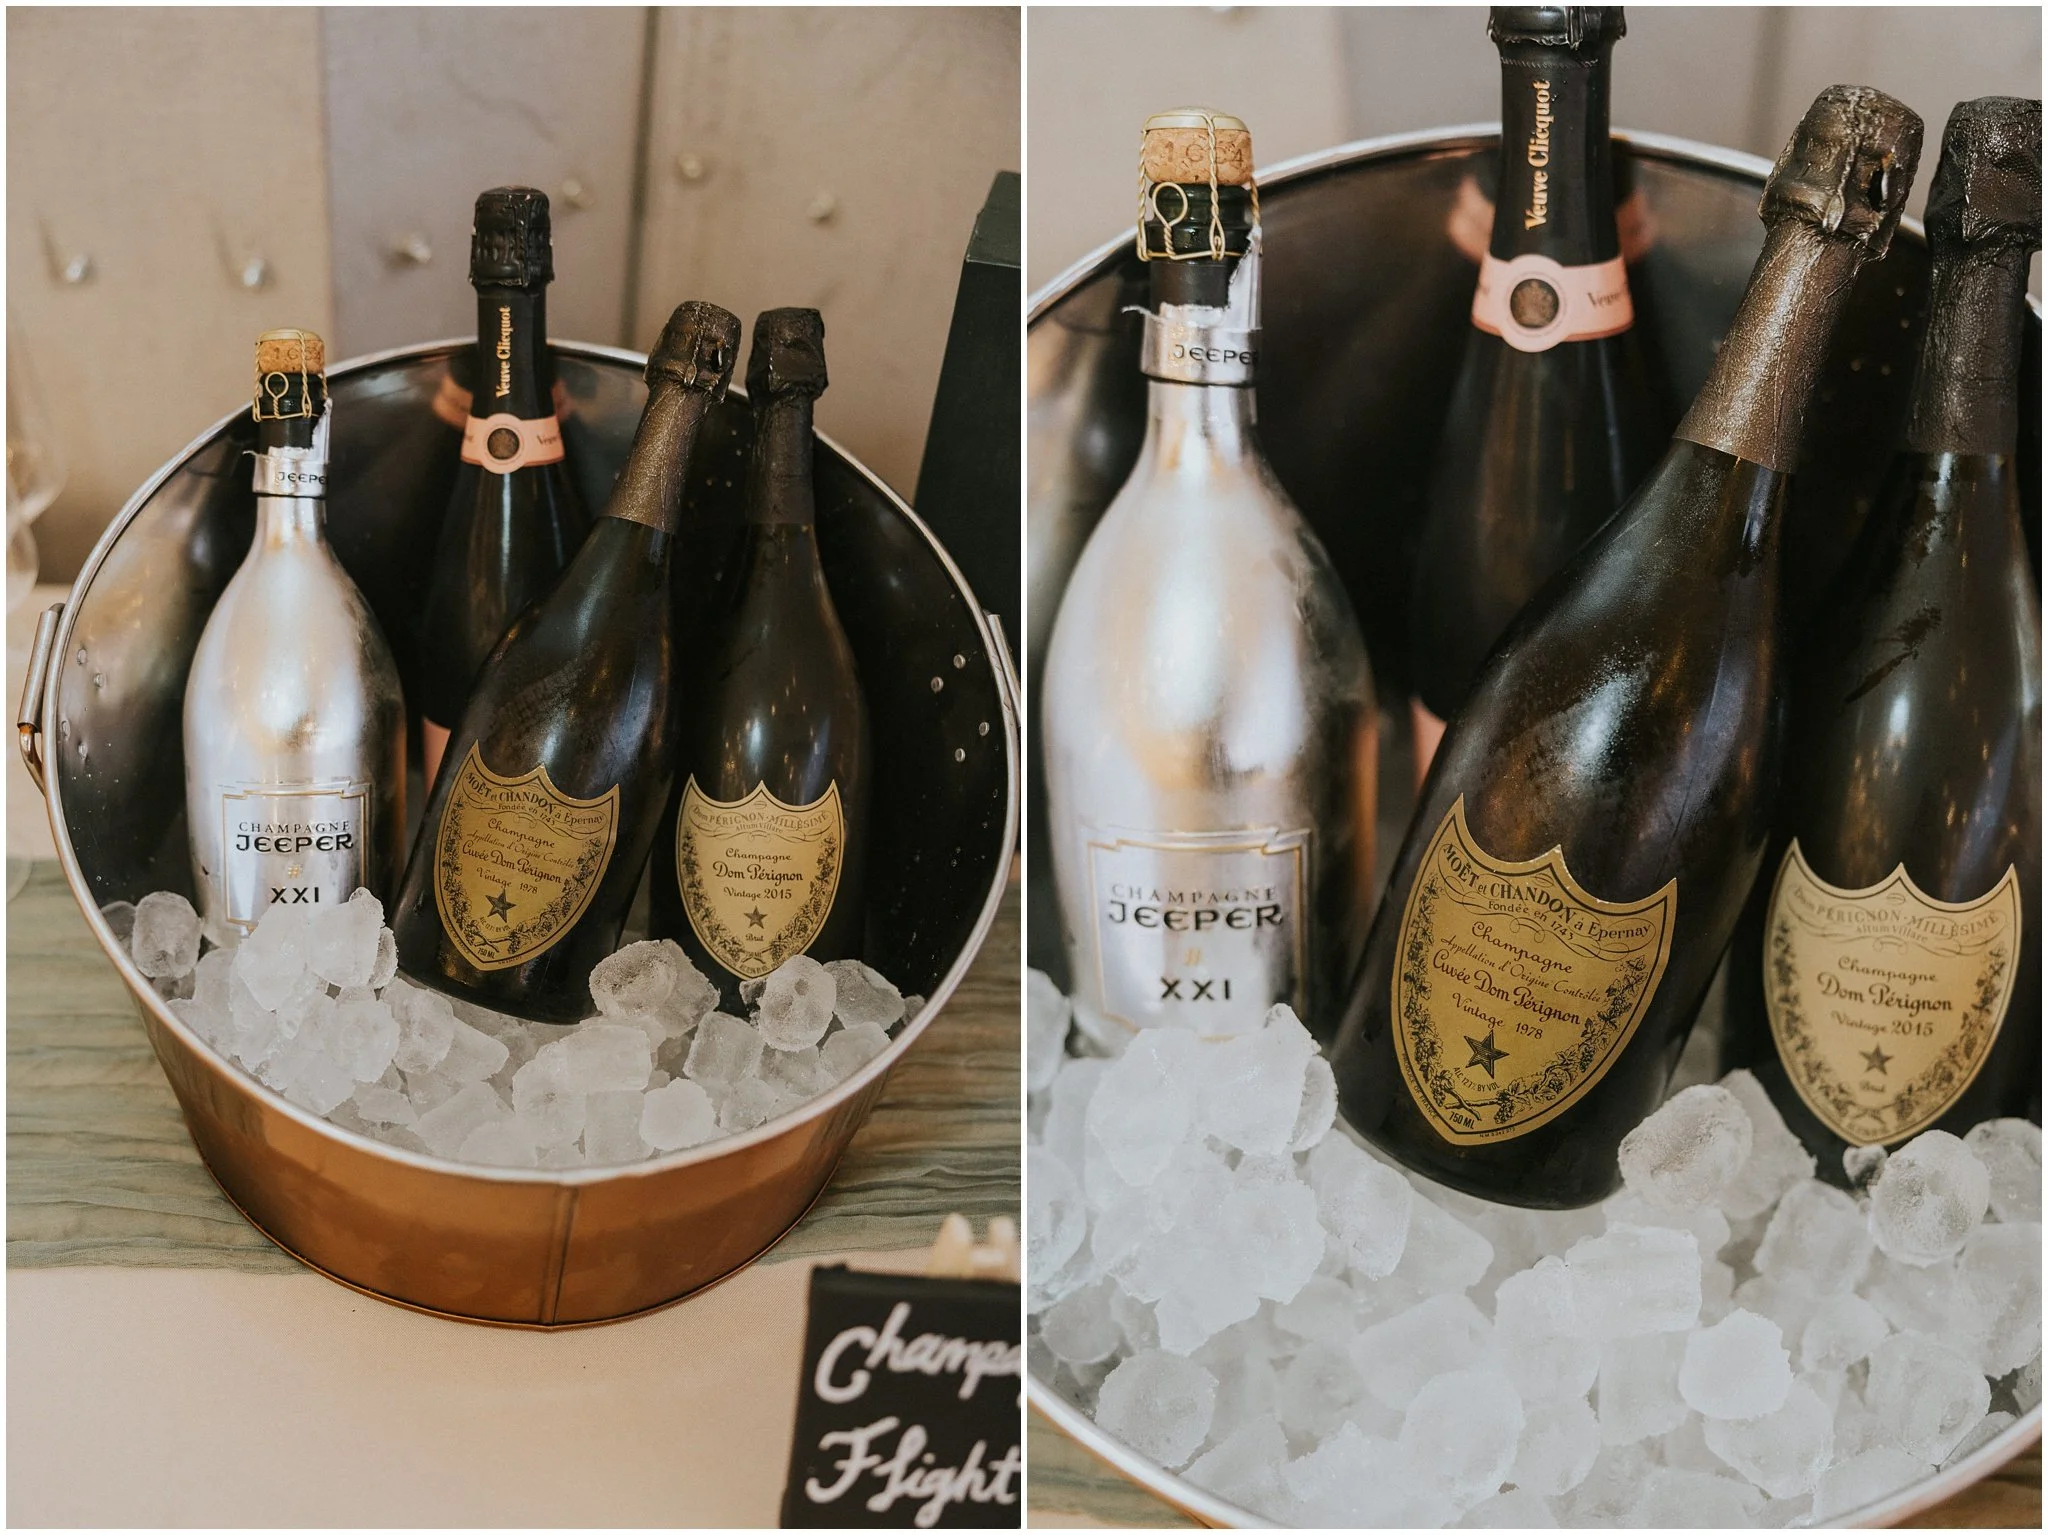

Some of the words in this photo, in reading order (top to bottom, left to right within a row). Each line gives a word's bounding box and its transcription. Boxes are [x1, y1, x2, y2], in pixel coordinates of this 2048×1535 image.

[1527, 79, 1554, 168] Clicquot
[1524, 170, 1549, 230] Veuve
[496, 306, 513, 360] Clicquot
[496, 361, 511, 398] Veuve
[277, 471, 329, 485] JEEPE
[499, 791, 557, 815] CHANDON
[236, 832, 354, 853] JEEPER
[238, 820, 351, 834] CHAMPAGNE
[488, 818, 555, 849] Champagne
[462, 840, 489, 861] Cuvée
[490, 849, 516, 870] Dom
[517, 858, 563, 883] Pérignon
[725, 847, 793, 864] Champagne
[476, 866, 512, 889] Vintage
[519, 882, 538, 895] 1978
[712, 860, 746, 879] Dom
[746, 863, 804, 887] Pérignon
[270, 886, 320, 904] XXI
[723, 886, 761, 902] Vintage
[763, 888, 792, 900] 2015
[1112, 883, 1280, 904] CHAMPAGNE
[1108, 900, 1284, 932] JEEPER
[1477, 883, 1487, 894] et
[1490, 882, 1576, 924] CHANDON
[1588, 921, 1651, 942] Epernay
[1488, 899, 1529, 913] Fondée
[1533, 909, 1547, 921] en
[1550, 920, 1574, 941] 1743
[1441, 935, 1496, 969] Appellation
[1471, 921, 1574, 974] Champagne
[1838, 956, 1938, 986] Champagne
[1160, 976, 1232, 1001] XXI
[1432, 949, 1471, 985] Cuvée
[1474, 969, 1511, 1002] Dom
[1513, 986, 1581, 1025] Pérignon
[1817, 971, 1865, 1004] Dom
[1868, 982, 1953, 1018] Pérignon
[1452, 992, 1505, 1029] Vintage
[1515, 1022, 1544, 1040] 1978
[1831, 1010, 1887, 1036] Vintage
[1891, 1019, 1934, 1037] 2015
[1477, 1083, 1486, 1092] BY
[1448, 1111, 1464, 1125] 750
[1463, 1116, 1475, 1130] ML
[814, 1301, 1021, 1404] Champa
[805, 1415, 1021, 1528] Flight
